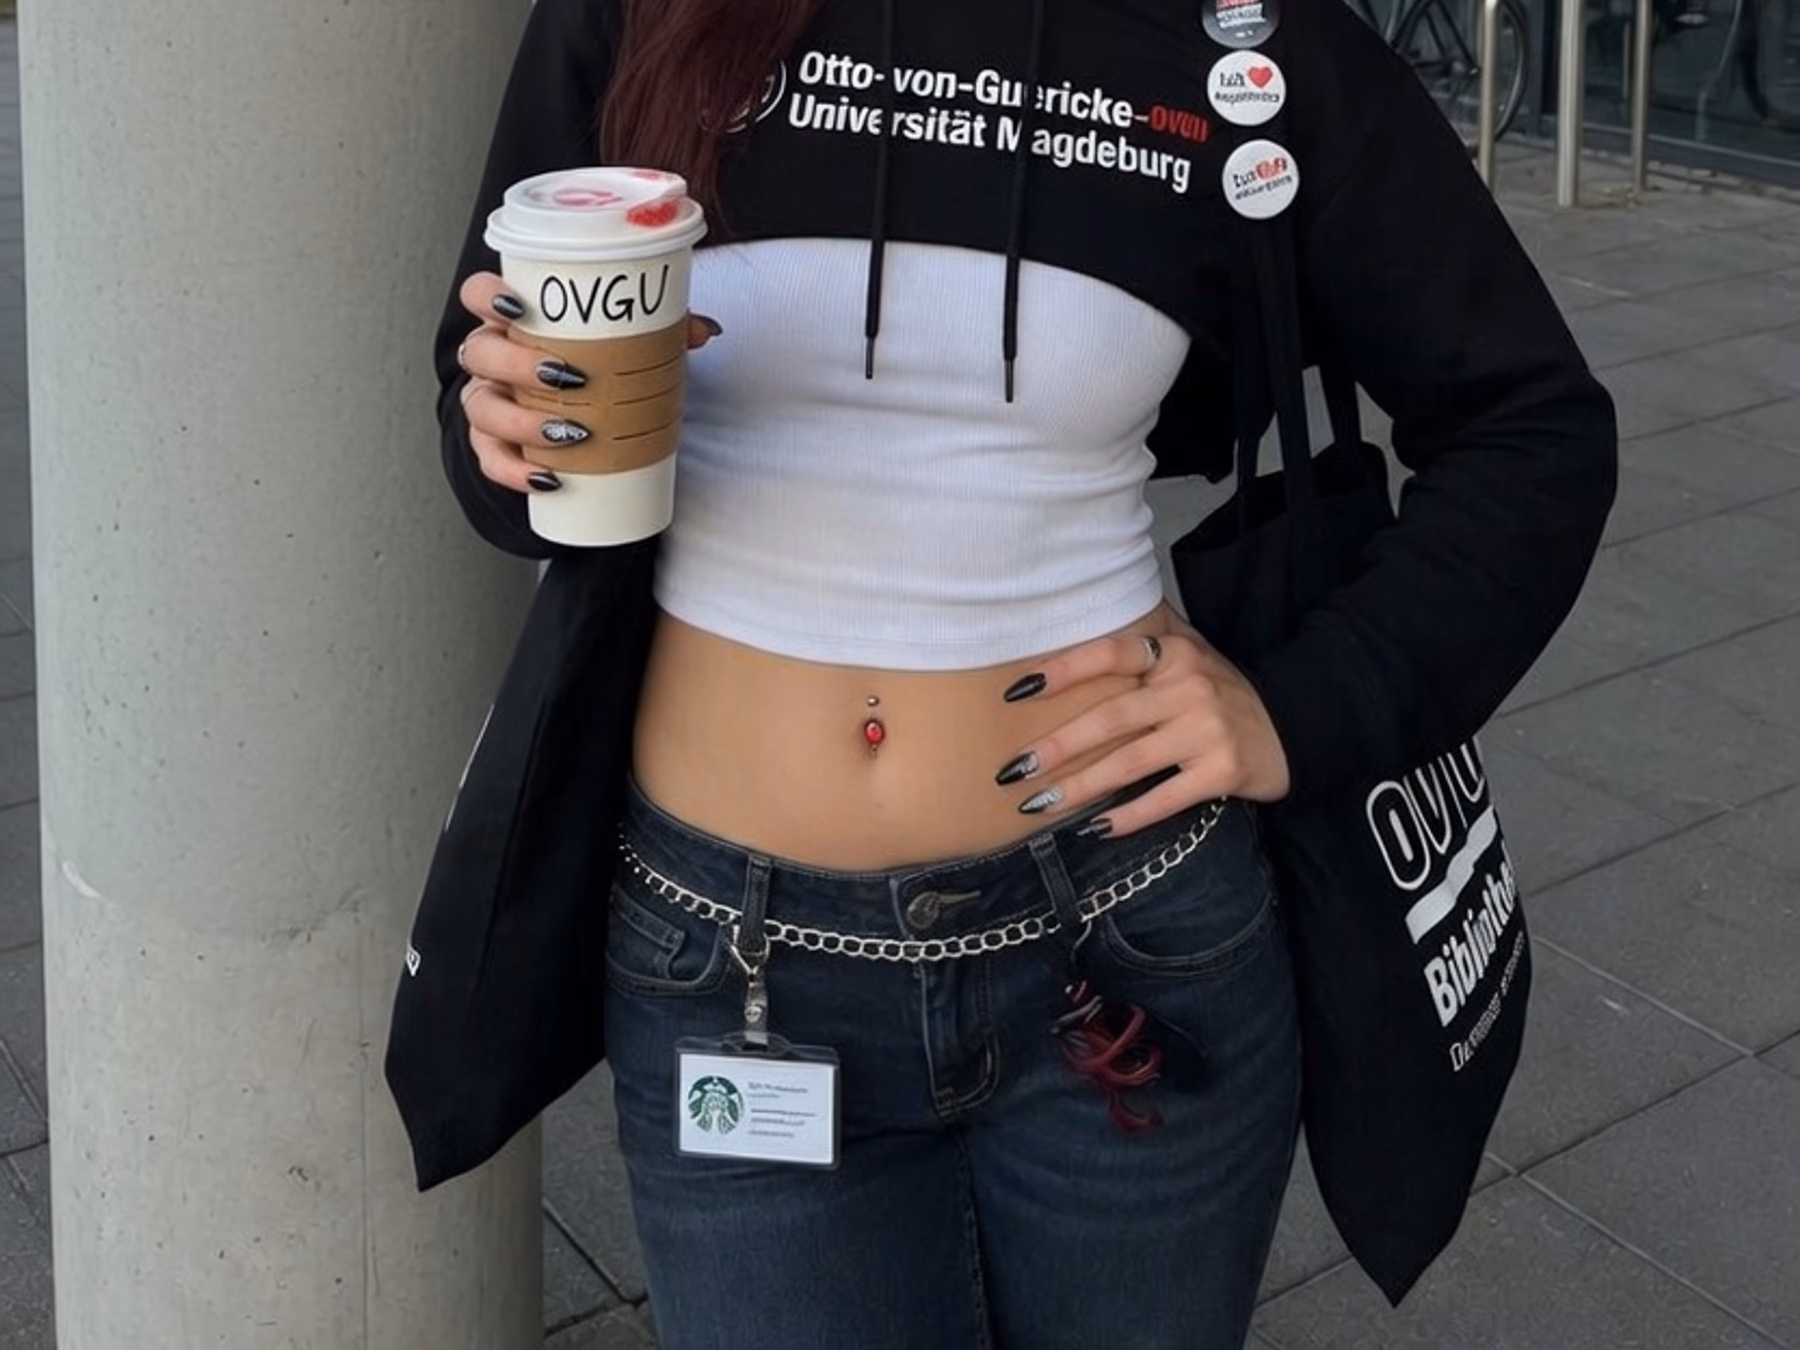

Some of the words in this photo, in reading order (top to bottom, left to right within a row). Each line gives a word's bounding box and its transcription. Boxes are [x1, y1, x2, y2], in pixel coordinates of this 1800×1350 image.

[789, 93, 987, 148] Universität
[996, 115, 1191, 194] Magdeburg
[540, 265, 669, 323] OVGU
